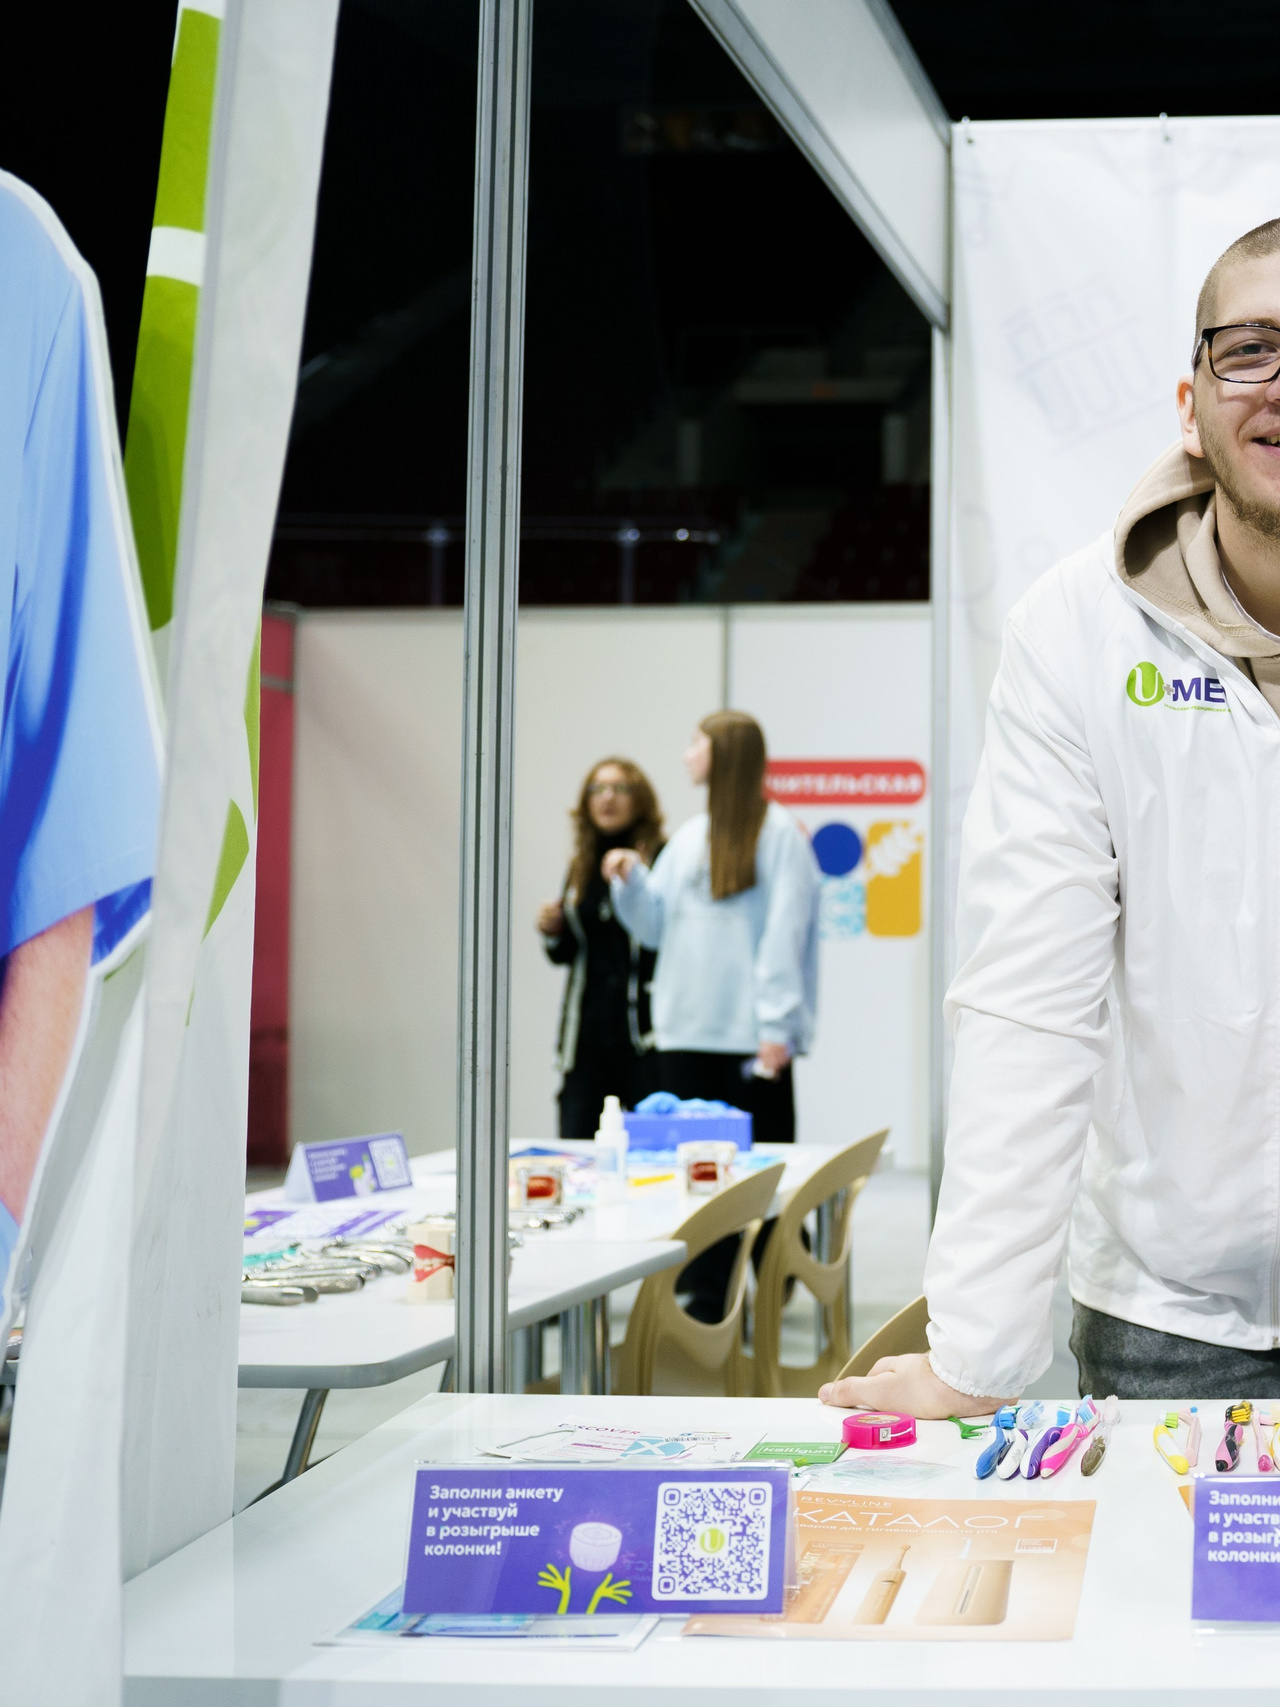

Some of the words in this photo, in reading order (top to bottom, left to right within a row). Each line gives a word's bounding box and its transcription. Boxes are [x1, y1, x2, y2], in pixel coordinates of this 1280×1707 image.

[558, 1423, 641, 1435] DSCOVER
[429, 1485, 502, 1501] Заполни
[506, 1487, 564, 1502] анкету
[801, 1495, 894, 1507] REVYLINE
[428, 1507, 439, 1518] и
[442, 1503, 518, 1521] участвуй
[793, 1507, 1046, 1530] КАТАЛОГ
[1209, 1513, 1220, 1524] и
[426, 1526, 437, 1536] в
[440, 1524, 540, 1540] розыгрыше
[1208, 1533, 1219, 1544] в
[424, 1541, 502, 1556] колонки!
